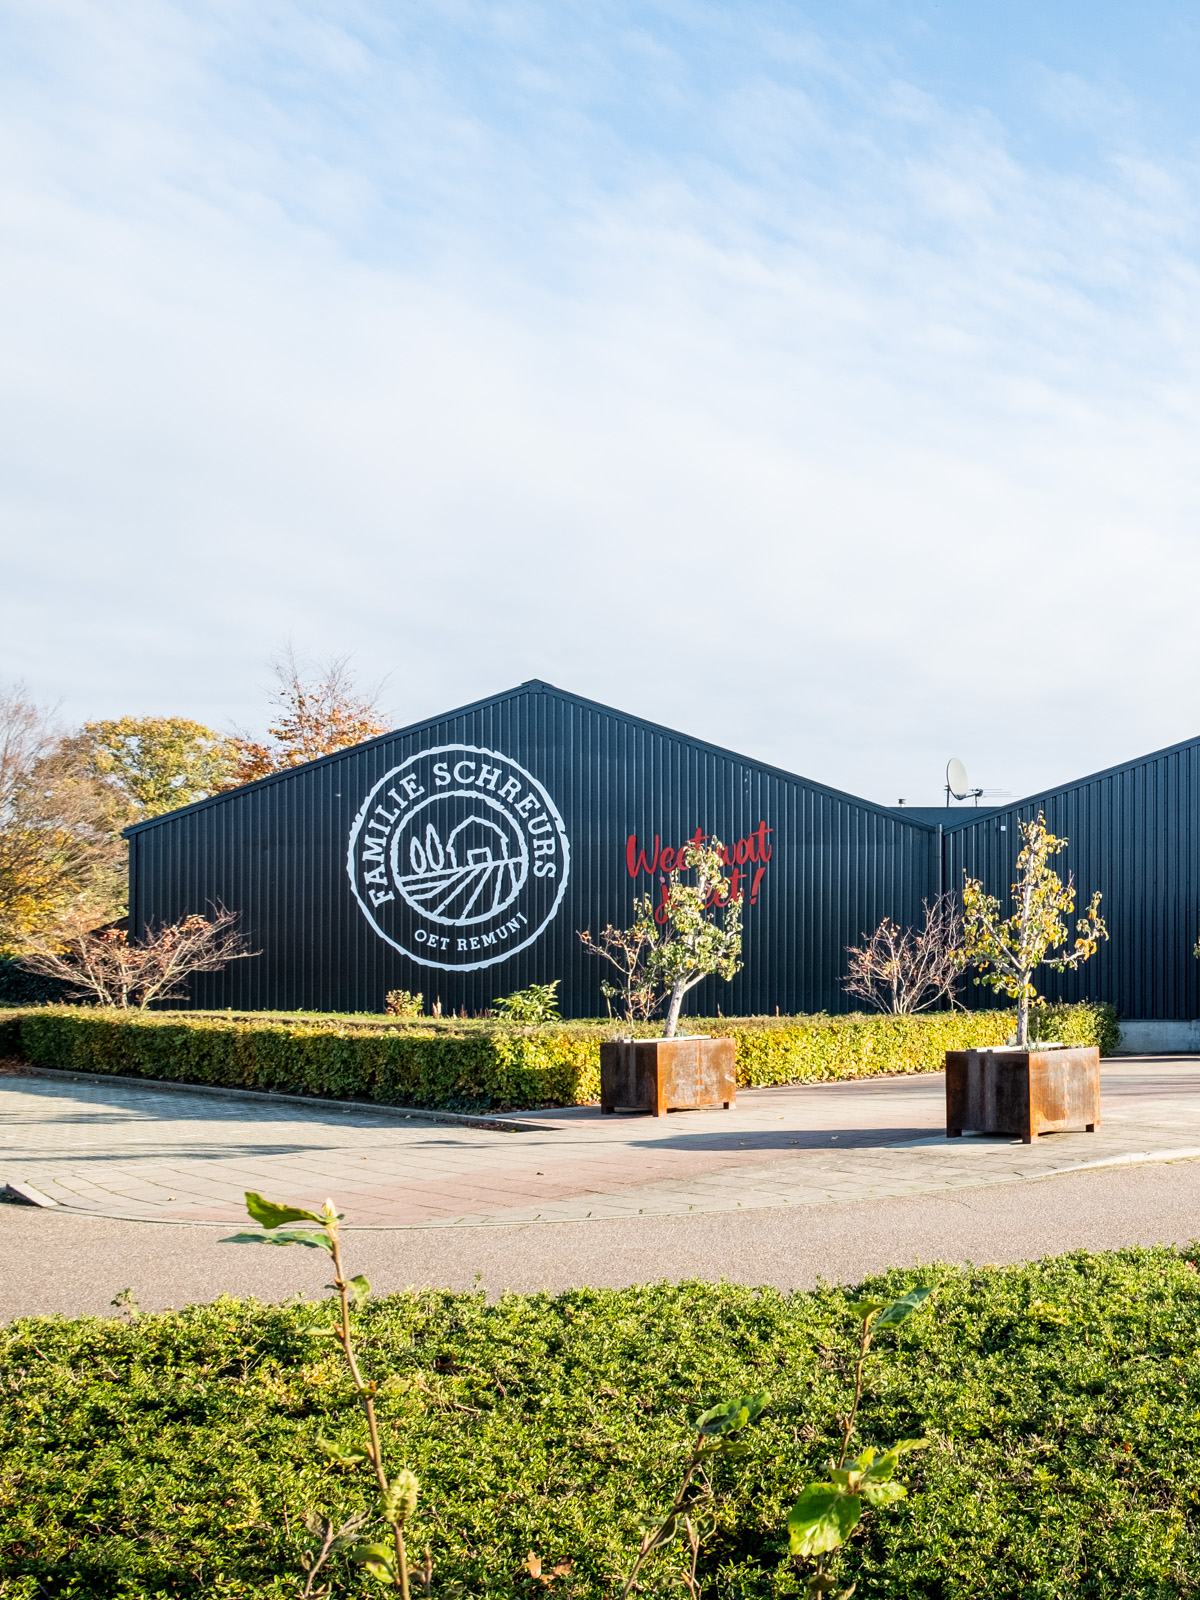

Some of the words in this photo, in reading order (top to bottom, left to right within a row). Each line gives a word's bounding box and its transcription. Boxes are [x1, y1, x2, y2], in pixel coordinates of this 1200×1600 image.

[362, 773, 425, 907] FAMILIE
[433, 761, 556, 878] SCHREURS
[714, 820, 774, 867] wat
[414, 929, 450, 950] OET
[457, 912, 528, 951] REMUNJ
